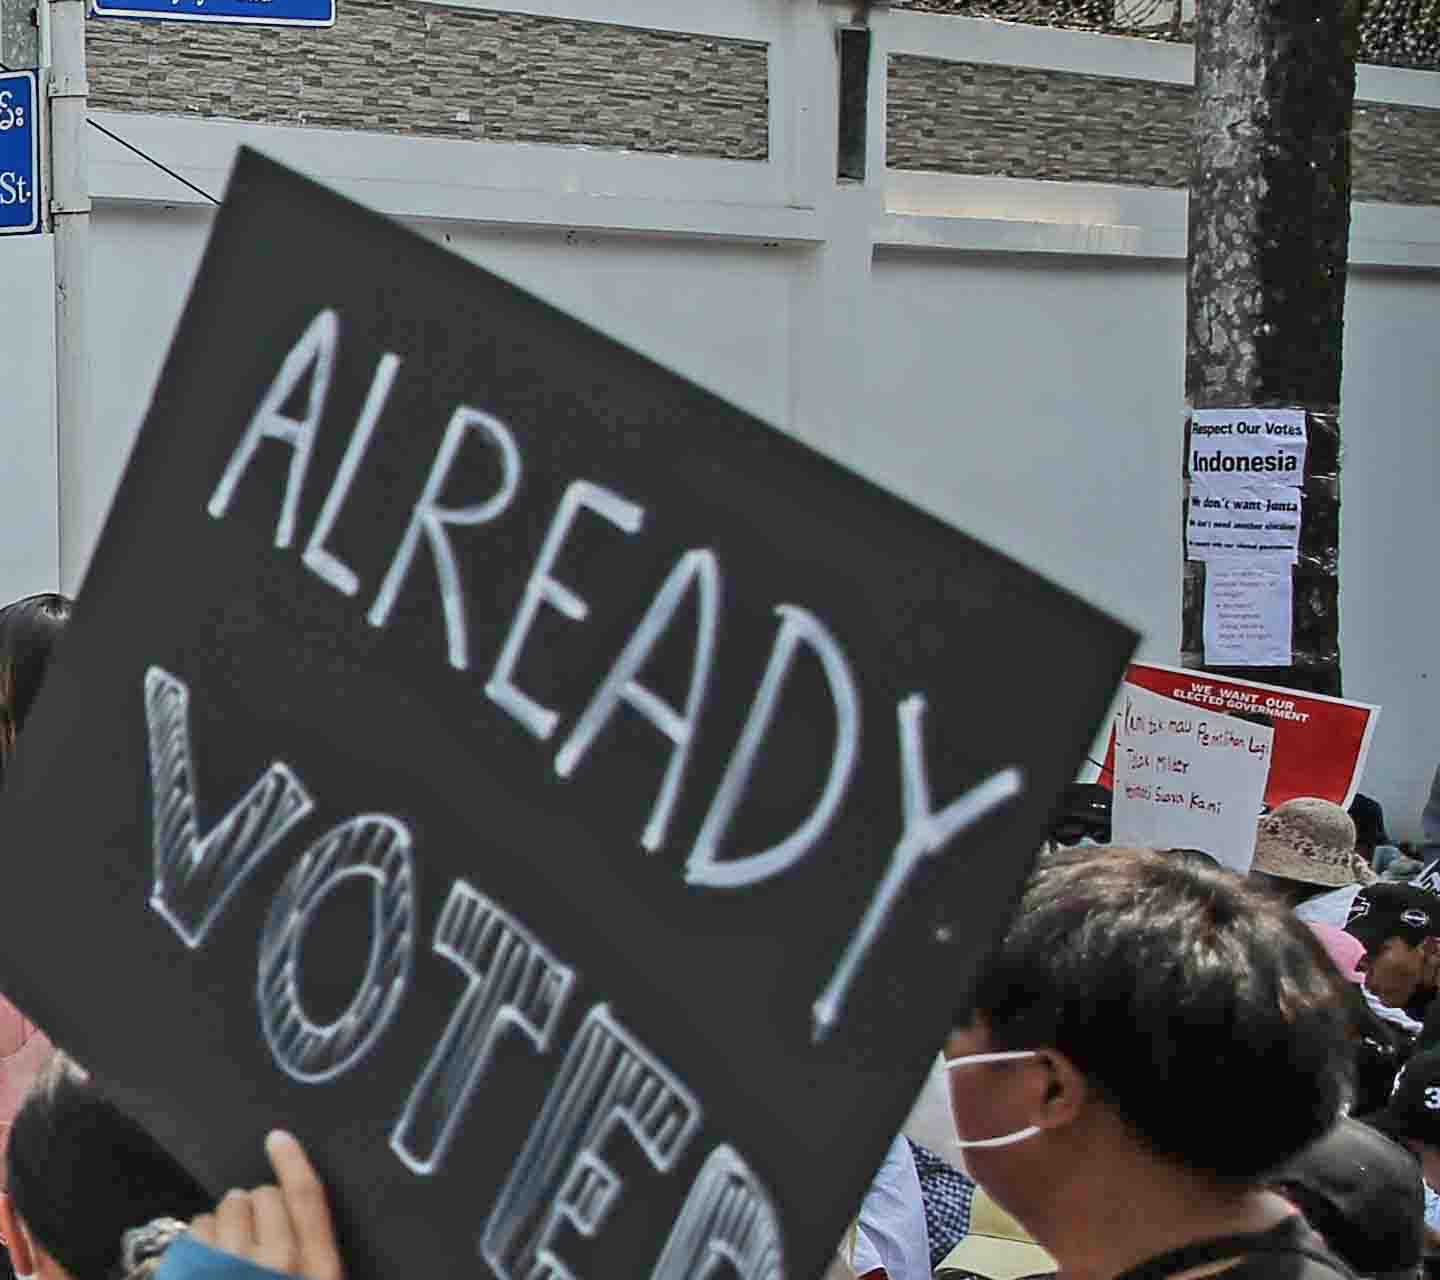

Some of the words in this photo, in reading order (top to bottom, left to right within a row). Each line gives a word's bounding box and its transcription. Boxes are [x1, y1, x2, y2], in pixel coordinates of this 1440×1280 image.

[0, 171, 32, 205] St.
[1191, 421, 1233, 438] Respect
[1236, 421, 1262, 435] Our
[1265, 421, 1303, 436] Votes
[1192, 449, 1297, 473] Indonesia
[1232, 498, 1262, 511] want
[206, 305, 1023, 1043] ALREADY
[1172, 688, 1228, 708] ELECTED
[1226, 698, 1311, 724] GOVERNMENT
[1191, 682, 1214, 696] WE
[1219, 687, 1260, 704] WANT
[1265, 695, 1296, 711] OUR
